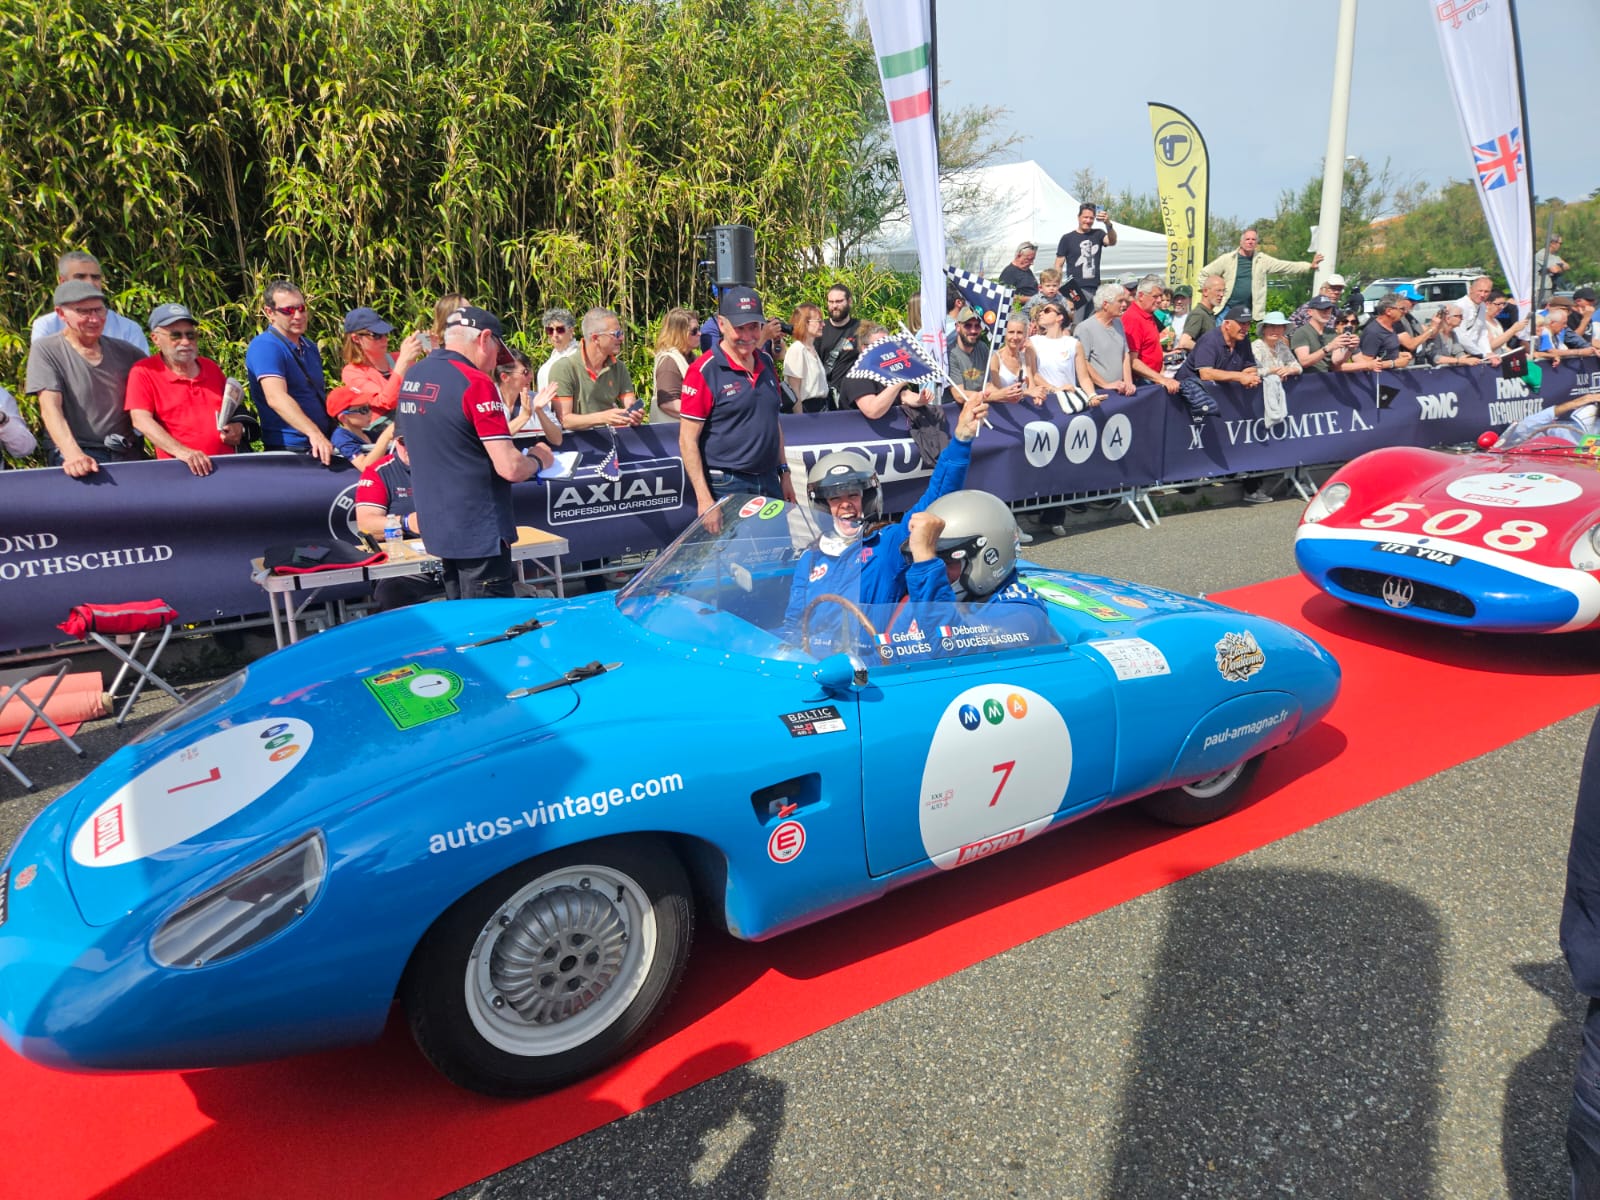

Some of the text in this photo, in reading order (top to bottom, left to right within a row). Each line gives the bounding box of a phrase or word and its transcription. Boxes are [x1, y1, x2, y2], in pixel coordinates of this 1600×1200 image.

[402, 381, 420, 392] TOUR
[1495, 377, 1530, 400] RMC
[1416, 392, 1459, 421] RMC
[1224, 410, 1344, 446] VICOMTE
[552, 476, 678, 509] AXIAL
[1488, 482, 1536, 493] 31
[553, 496, 679, 519] PROFESSION CARROSSIER
[763, 503, 779, 516] B
[1359, 502, 1548, 552] 508
[0, 544, 174, 582] OTHSCHILD
[1417, 547, 1455, 566] YUA
[892, 630, 926, 643] Gérard
[952, 624, 989, 636] Déborah
[955, 632, 1030, 649] DUCÈS-LASBATS
[896, 642, 932, 656] DUCÈS
[787, 708, 832, 722] BALTIC
[1203, 709, 1289, 751] paul-armagnac.fr
[988, 759, 1017, 808] 7
[428, 773, 685, 854] autos-vintage.com
